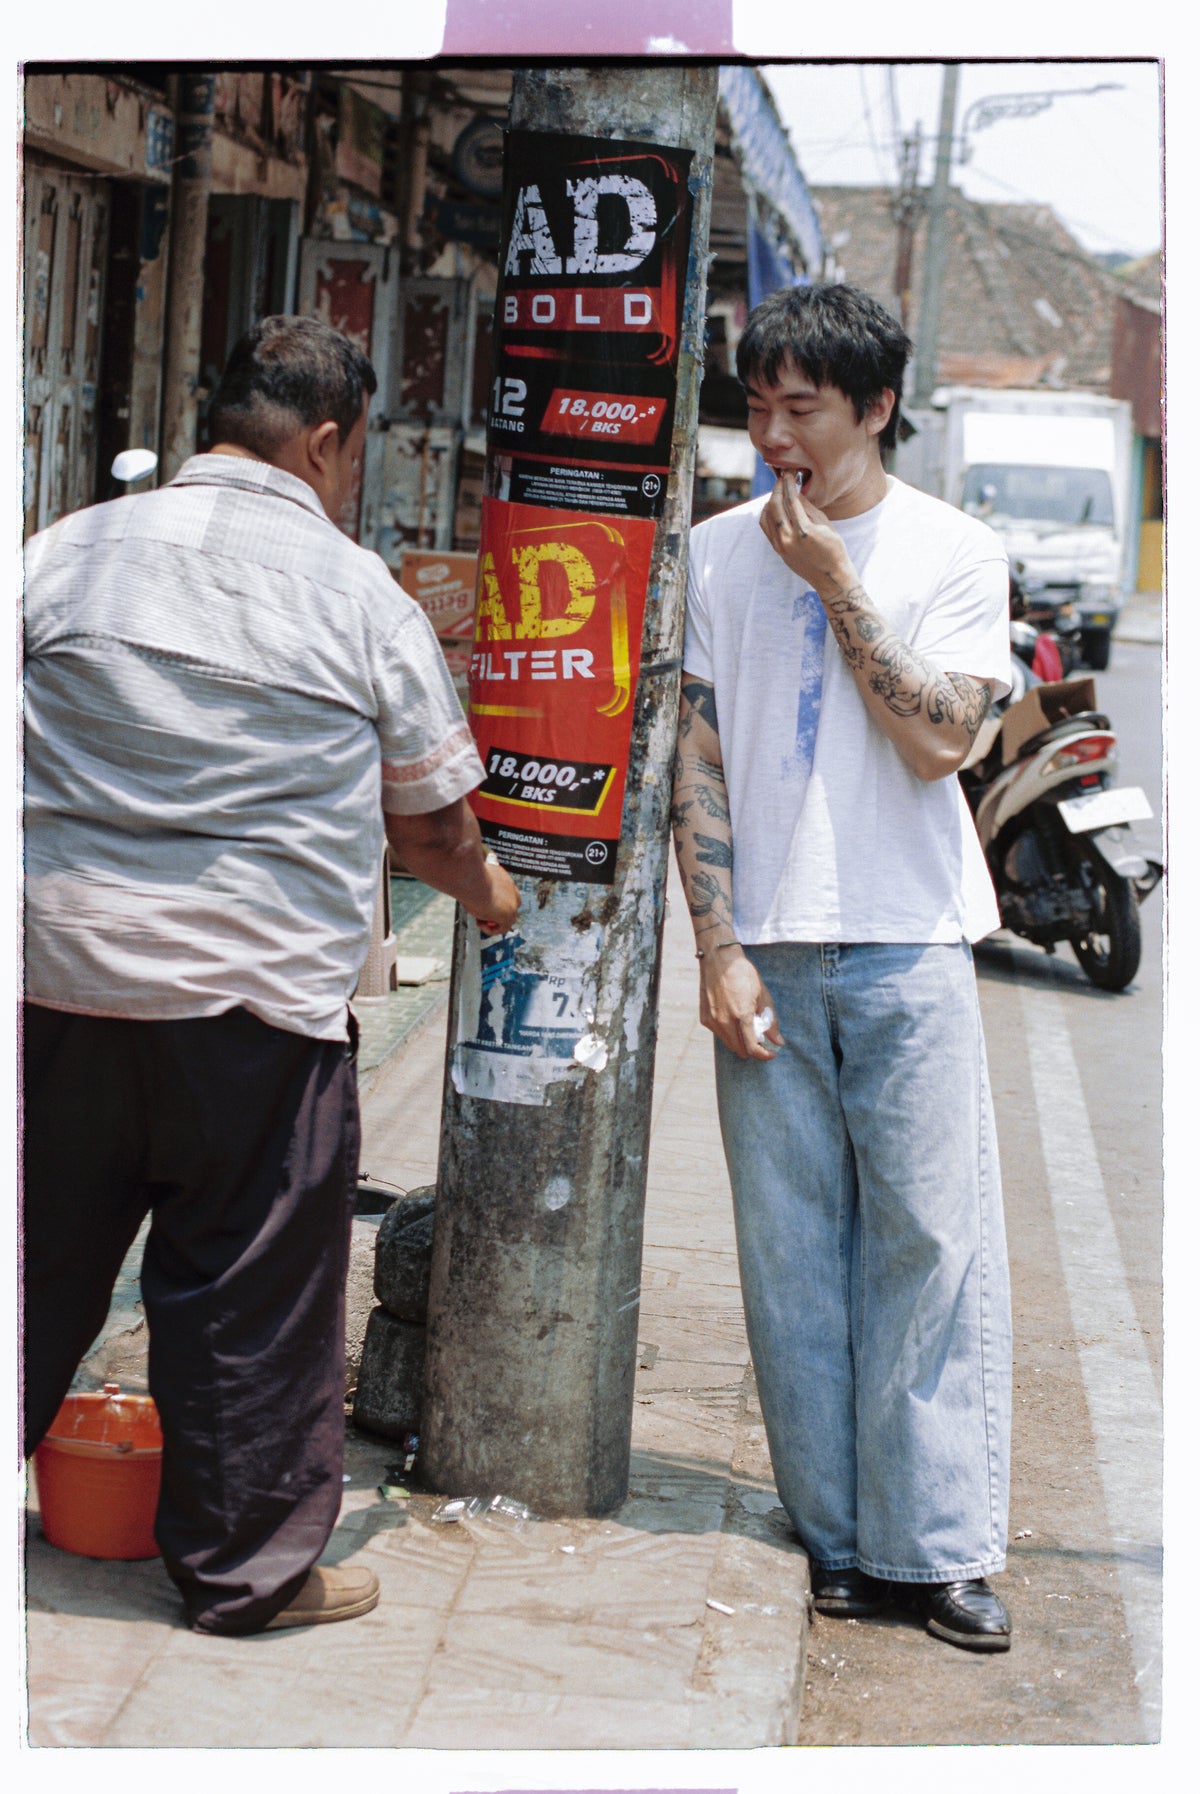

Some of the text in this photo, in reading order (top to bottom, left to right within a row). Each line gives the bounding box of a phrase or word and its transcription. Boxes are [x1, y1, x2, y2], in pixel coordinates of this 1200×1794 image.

[504, 174, 657, 276] AD
[503, 293, 652, 325] BOLD
[492, 376, 527, 417] 12
[591, 421, 621, 434] BKS
[549, 466, 600, 480] PERINGATAN
[644, 480, 659, 491] 21+
[475, 542, 597, 642] AD
[471, 648, 596, 680] FILTER
[520, 785, 557, 802] BKS
[497, 830, 544, 846] PERINGATAN
[588, 847, 605, 858] 21+
[552, 992, 570, 1018] 7
